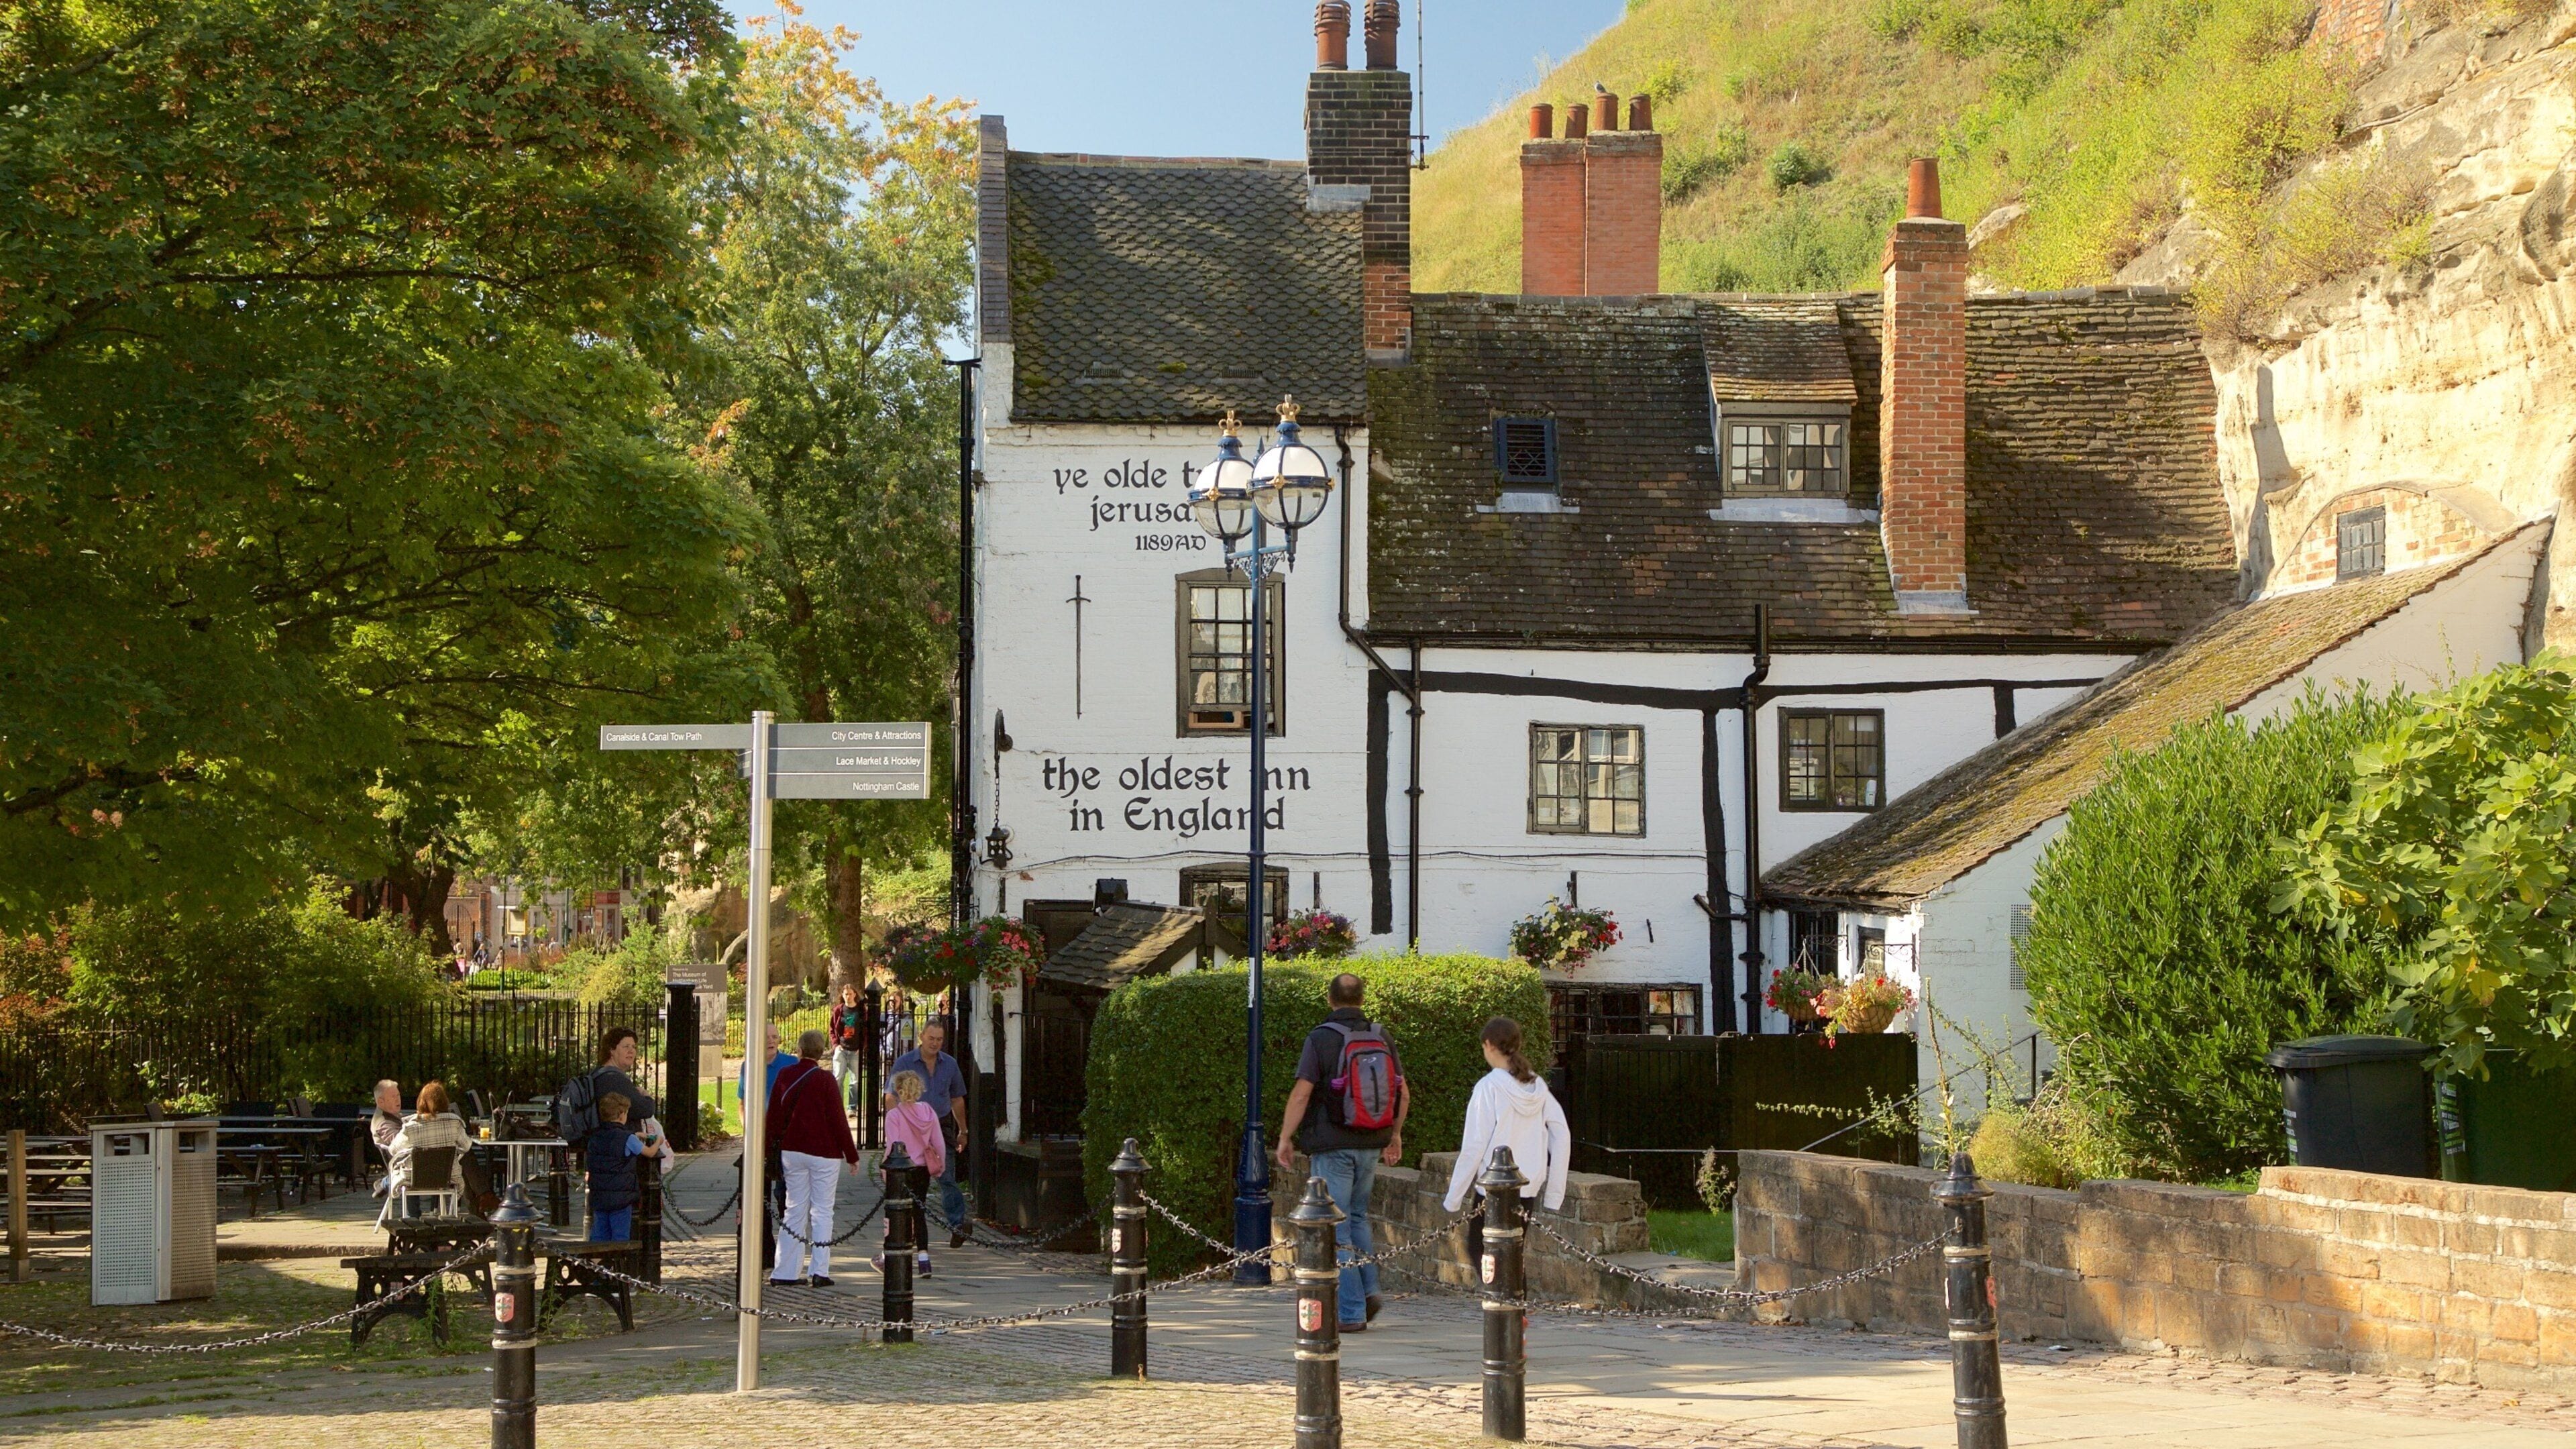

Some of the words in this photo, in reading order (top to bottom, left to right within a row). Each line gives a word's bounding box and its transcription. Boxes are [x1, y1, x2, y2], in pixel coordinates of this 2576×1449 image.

[1053, 468, 1088, 494] ye
[1104, 458, 1167, 488] olde
[1089, 495, 1199, 531] jerusa
[606, 733, 640, 741] Canalside
[641, 733, 647, 741] &
[649, 733, 669, 741] Canal
[670, 733, 685, 741] Tow
[686, 732, 702, 741] Path
[831, 731, 847, 742] City
[848, 731, 873, 740] Centre
[874, 731, 881, 740] &
[881, 731, 922, 740] Attractions
[836, 757, 854, 765] Lace
[855, 756, 882, 765] Market
[883, 756, 890, 765] &
[891, 756, 921, 767] Hockley
[853, 782, 894, 793] Nottingham
[896, 782, 920, 791] Castle
[1042, 757, 1101, 798] the
[1118, 755, 1231, 790] oldest
[1249, 767, 1311, 790] nn
[1070, 799, 1105, 832] in
[1124, 796, 1285, 838] England
